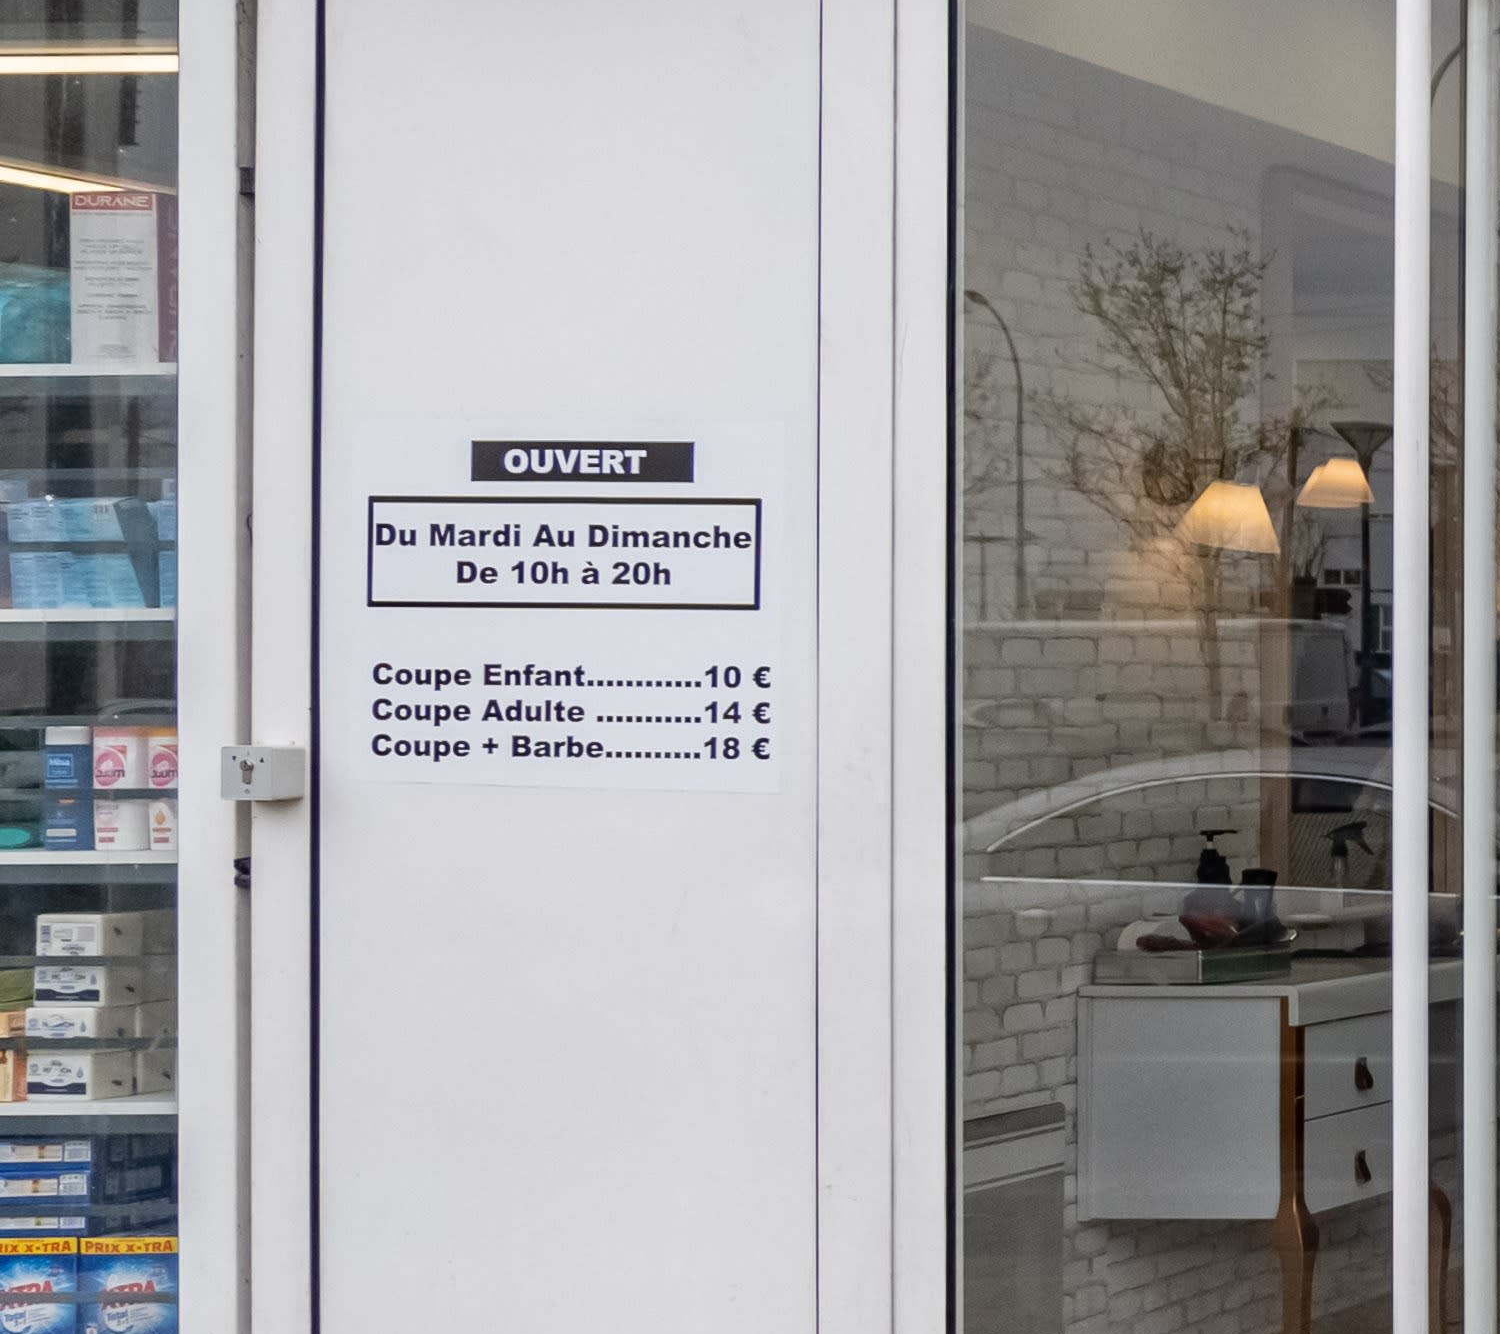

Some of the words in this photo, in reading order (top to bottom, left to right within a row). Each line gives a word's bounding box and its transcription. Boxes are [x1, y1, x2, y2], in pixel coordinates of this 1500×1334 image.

[504, 449, 647, 475] OUVERT
[375, 523, 417, 547] Du
[429, 523, 521, 548] Mardi
[533, 524, 576, 548] Au
[588, 524, 752, 549] Dimanche
[456, 561, 499, 584] De
[511, 560, 569, 585] 10h
[581, 560, 600, 585] à
[611, 562, 671, 585] 20h
[372, 663, 472, 691] Coupe
[483, 663, 586, 687] Enfant
[704, 665, 742, 689] 10
[752, 665, 771, 689] €
[371, 698, 471, 727] Coupe
[482, 699, 585, 723] Adulte
[704, 700, 742, 724] 14
[752, 701, 771, 724] €
[371, 734, 470, 763] Coupe
[482, 738, 499, 754] +
[511, 734, 605, 758] Barbe
[703, 736, 741, 760] 18
[752, 737, 771, 760] €
[85, 1241, 120, 1253] PRIX
